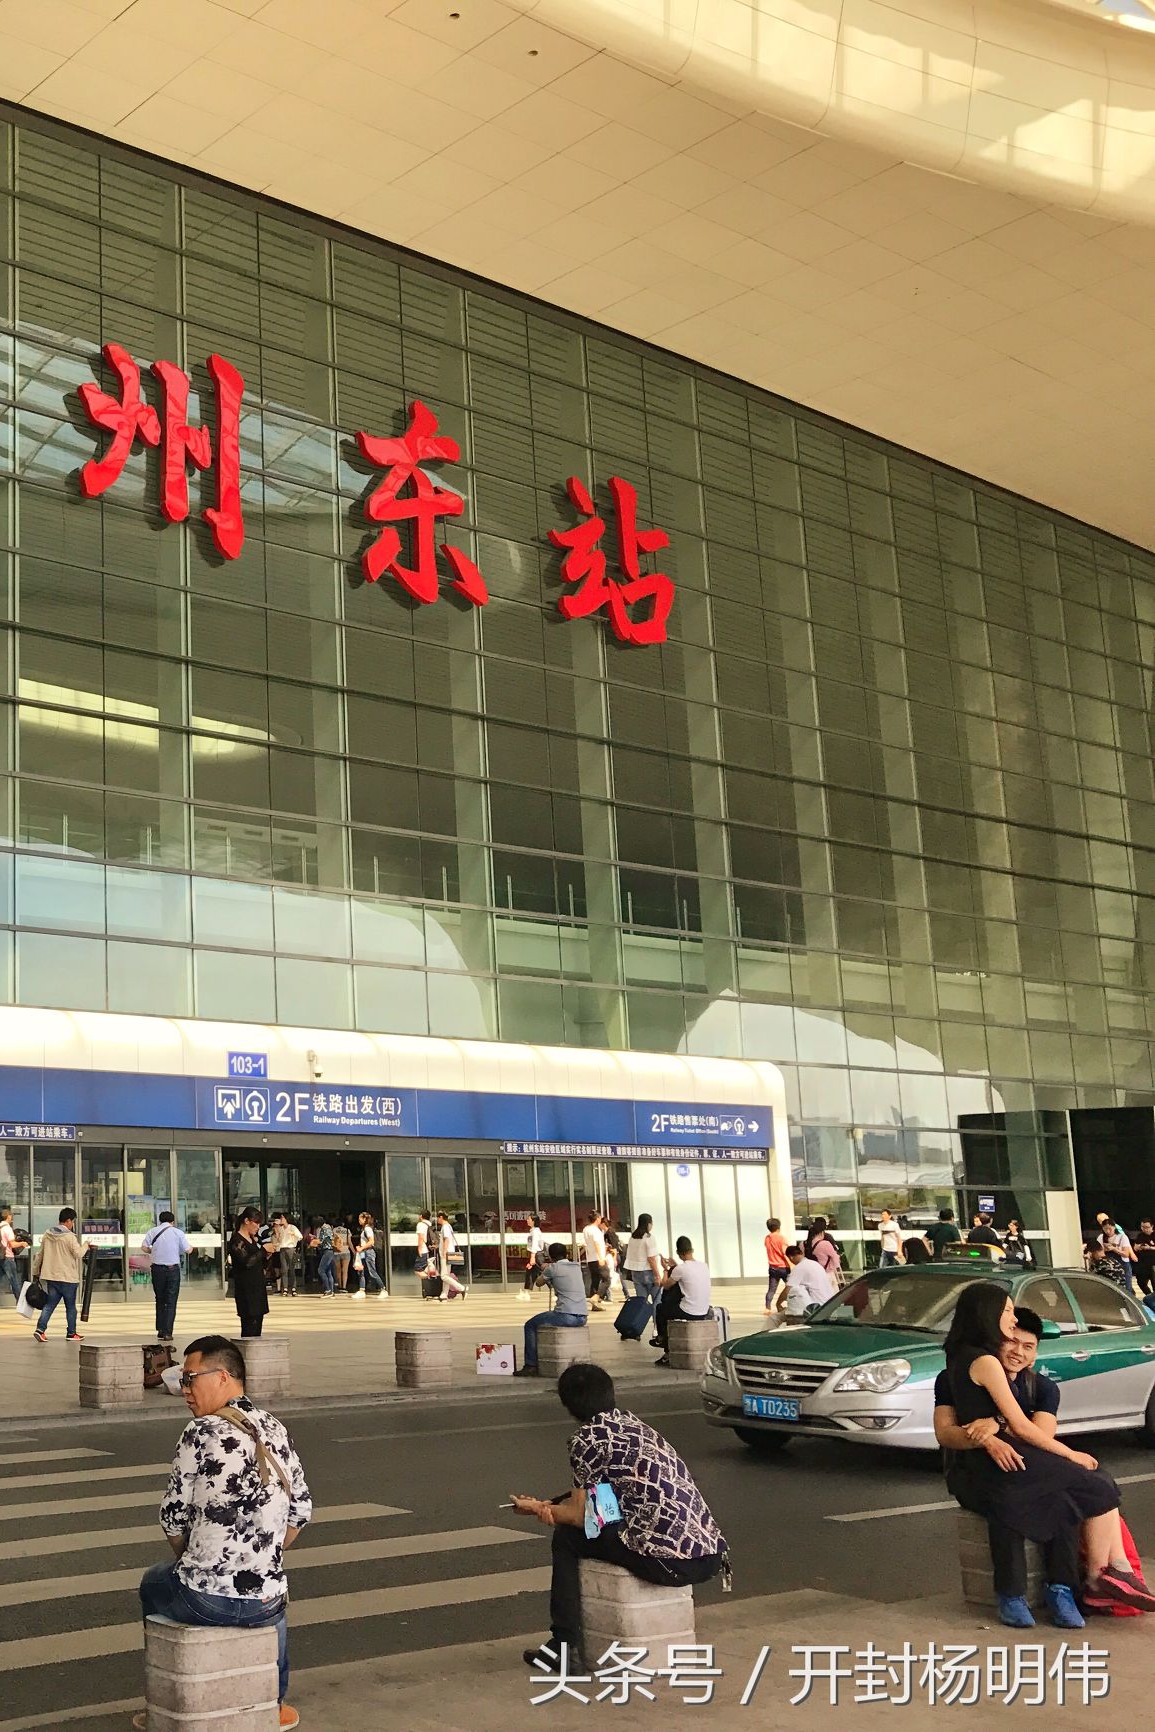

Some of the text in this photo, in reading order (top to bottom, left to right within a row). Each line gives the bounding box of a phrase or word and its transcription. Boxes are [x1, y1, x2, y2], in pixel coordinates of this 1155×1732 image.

[230, 1055, 265, 1075] 103-1
[275, 1092, 402, 1122] 2F 铁路出发(西)
[313, 1115, 401, 1127] Railway Departures (West)
[651, 1114, 669, 1132] 2F
